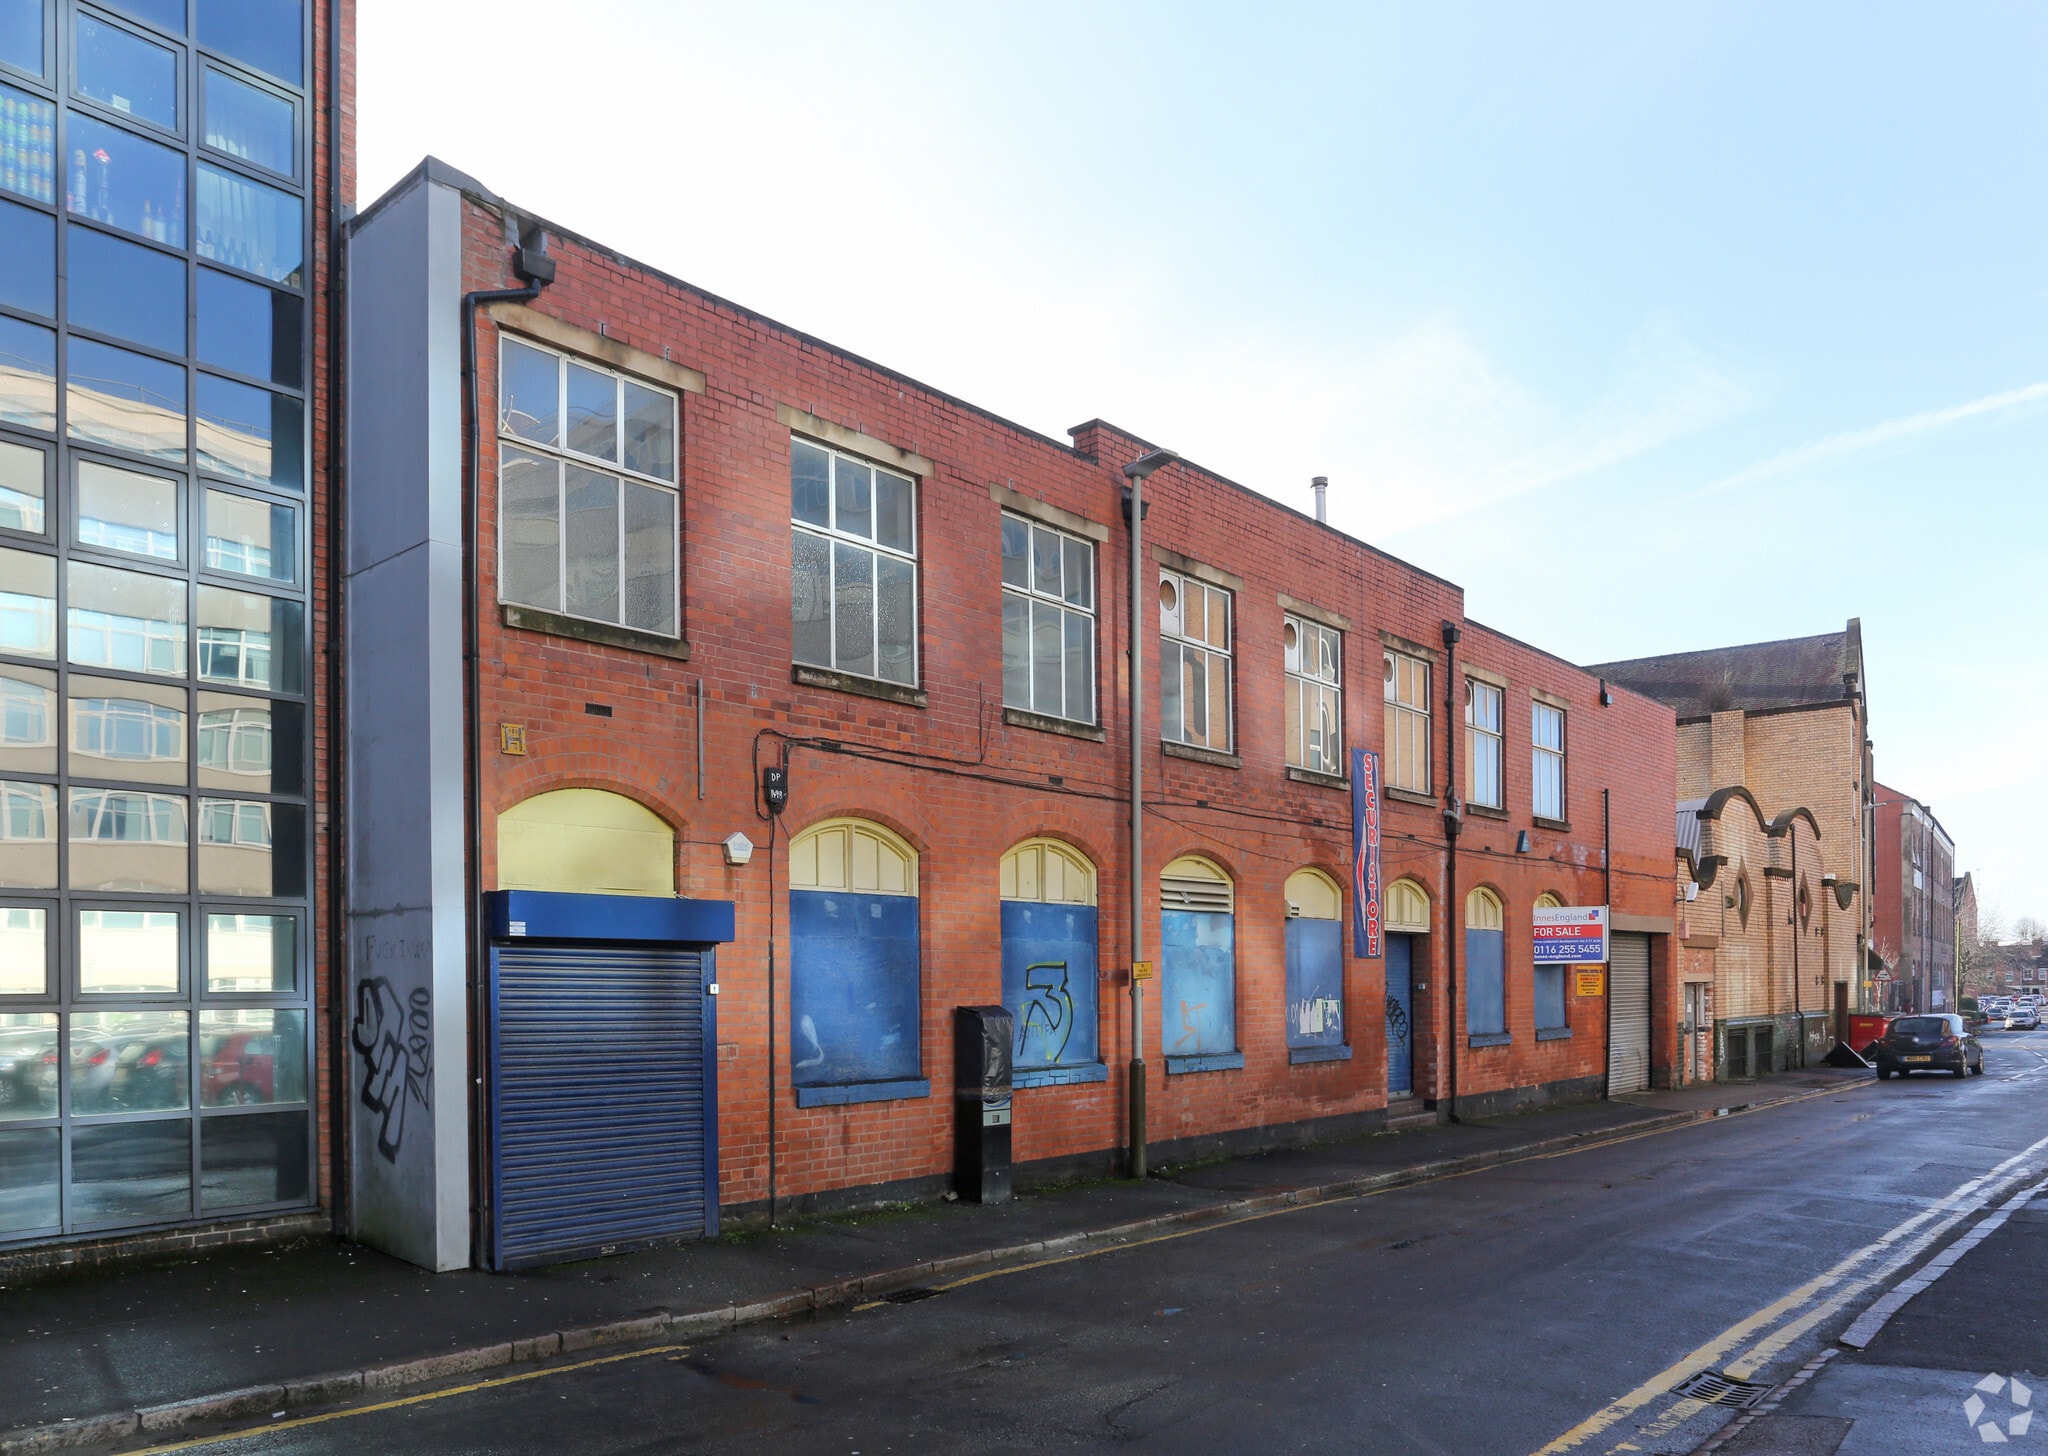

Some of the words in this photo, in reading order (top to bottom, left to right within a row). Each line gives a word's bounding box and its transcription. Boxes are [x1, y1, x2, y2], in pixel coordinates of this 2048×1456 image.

[771, 772, 781, 782] DP
[1363, 753, 1379, 956] SECURISTORE
[1534, 913, 1588, 922] InnesEngland
[1534, 928, 1554, 936] FOR
[1556, 926, 1582, 936] SALE
[1534, 945, 1556, 954] 0116
[1558, 945, 1576, 954] 255
[1578, 944, 1600, 953] 5455
